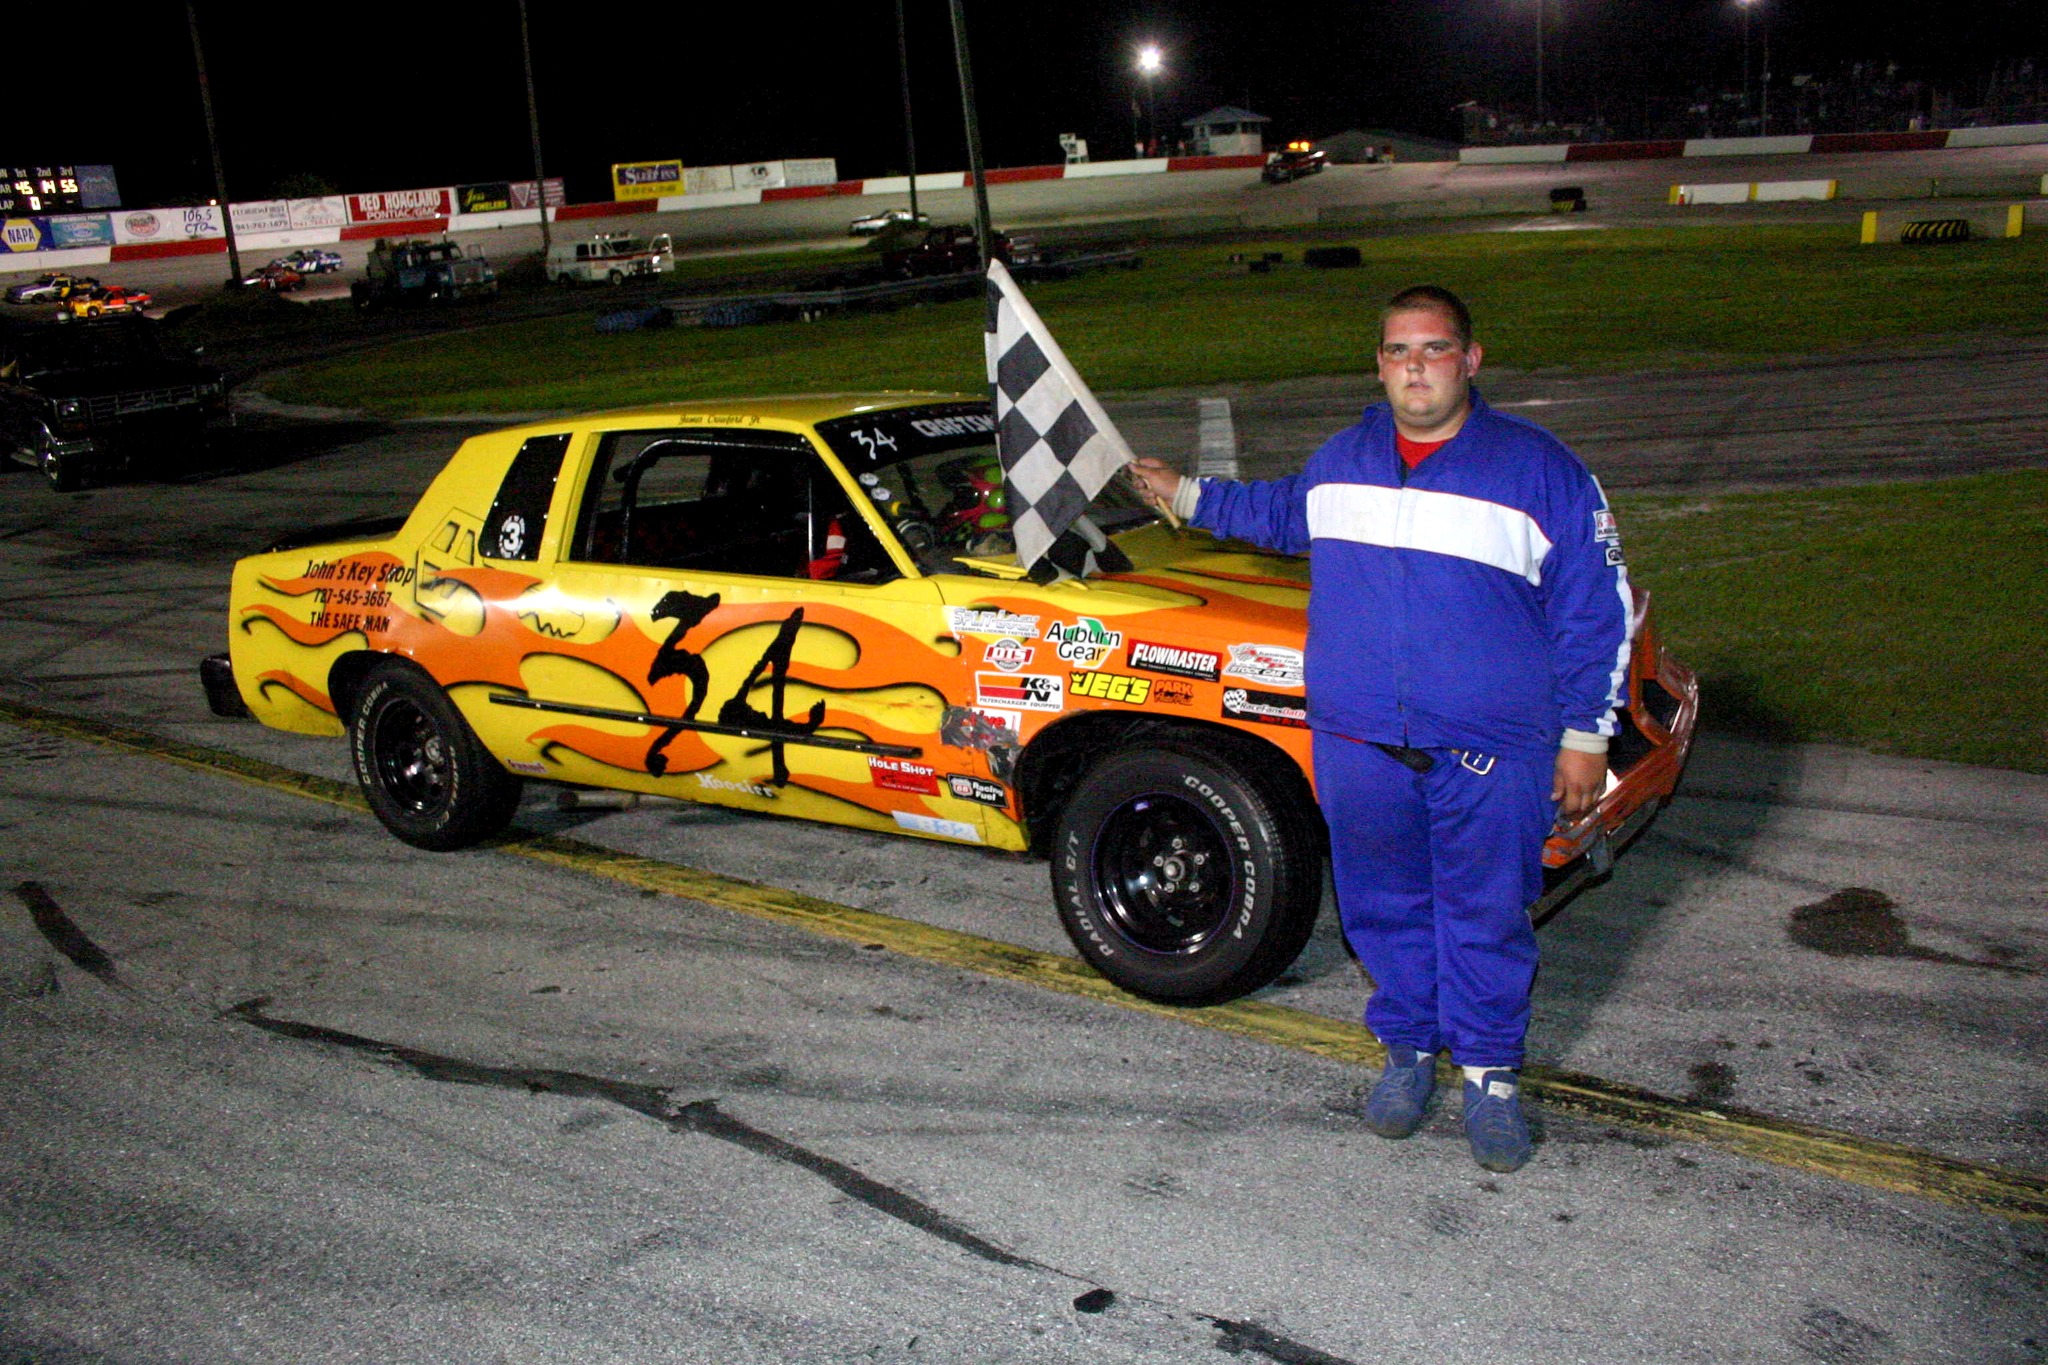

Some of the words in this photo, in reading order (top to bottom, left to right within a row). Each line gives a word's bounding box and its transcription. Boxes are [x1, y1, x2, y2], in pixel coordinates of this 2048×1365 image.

[15, 181, 34, 195] 45
[60, 179, 79, 194] 55
[359, 194, 381, 212] RED
[384, 190, 441, 209] HOAGLAND
[182, 208, 212, 222] 106.5
[7, 228, 36, 243] NAPA
[850, 427, 898, 460] 34
[503, 522, 521, 551] 3
[303, 560, 346, 580] John's
[347, 562, 377, 586] Key
[376, 563, 417, 587] Shop
[310, 611, 332, 628] THE
[333, 613, 361, 631] SAFE
[363, 615, 391, 632] MAN
[1046, 622, 1121, 647] Auburn
[1059, 641, 1105, 661] Gear
[1130, 643, 1217, 673] FLOWMASTER
[645, 590, 826, 788] 34
[1069, 670, 1151, 704] JEG'S
[980, 698, 1027, 706] FILTERCHARGER
[357, 718, 371, 784] COOPER
[868, 757, 898, 771] HOLE
[900, 761, 934, 777] SHOT
[695, 773, 773, 798] Hoosier
[956, 785, 969, 793] 66
[972, 781, 1004, 796] Racing
[975, 791, 996, 801] Fuel
[1182, 775, 1250, 850] COOPER
[1233, 860, 1256, 939] COBRA
[1069, 880, 1114, 956] RADIAL
